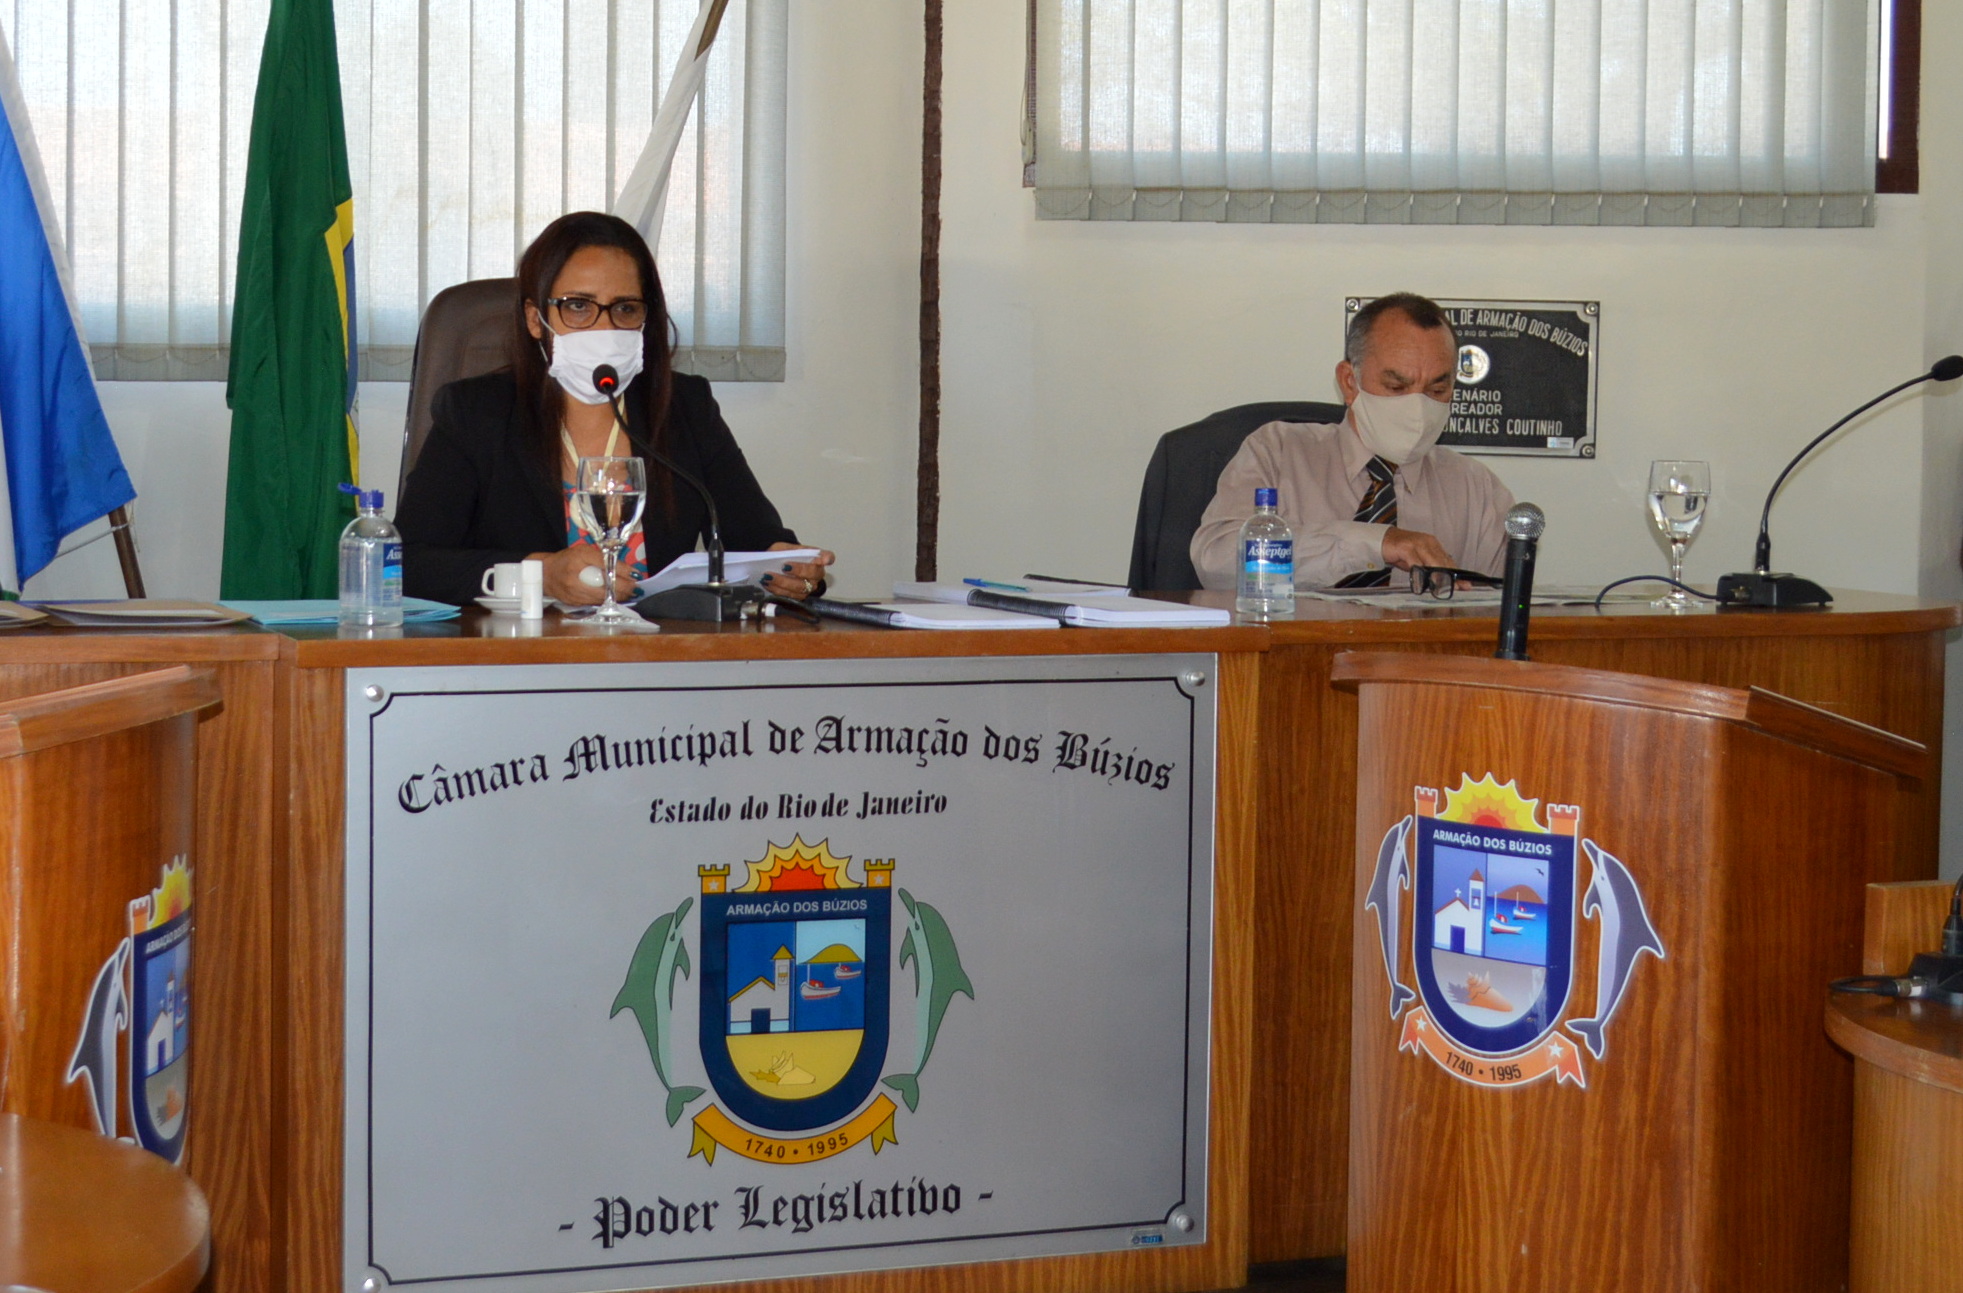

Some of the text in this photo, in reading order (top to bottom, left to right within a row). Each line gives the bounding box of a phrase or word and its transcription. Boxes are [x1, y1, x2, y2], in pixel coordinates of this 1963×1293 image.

[1460, 309, 1474, 325] DE
[1476, 310, 1527, 332] ARMAÇÃO
[1528, 318, 1551, 340] DOS
[1550, 327, 1588, 357] BÚZIOS
[1451, 402, 1503, 415] READOR
[1453, 388, 1502, 402] ENÁRIO
[1506, 418, 1563, 436] COUTINHO
[398, 714, 1176, 814] Câmara Municipal de Armação dos Búzios
[649, 789, 948, 824] Estado do Rio de Janeiro
[1433, 829, 1552, 855] ARMAÇÃO DOS BÚZIOS
[726, 898, 868, 917] ARMAÇÃO DOS BÚZIOS
[1446, 1051, 1522, 1081] 1740 1995
[745, 1132, 849, 1159] 1740 1995
[591, 1195, 720, 1248] Poder
[734, 1175, 962, 1233] Legislativo
